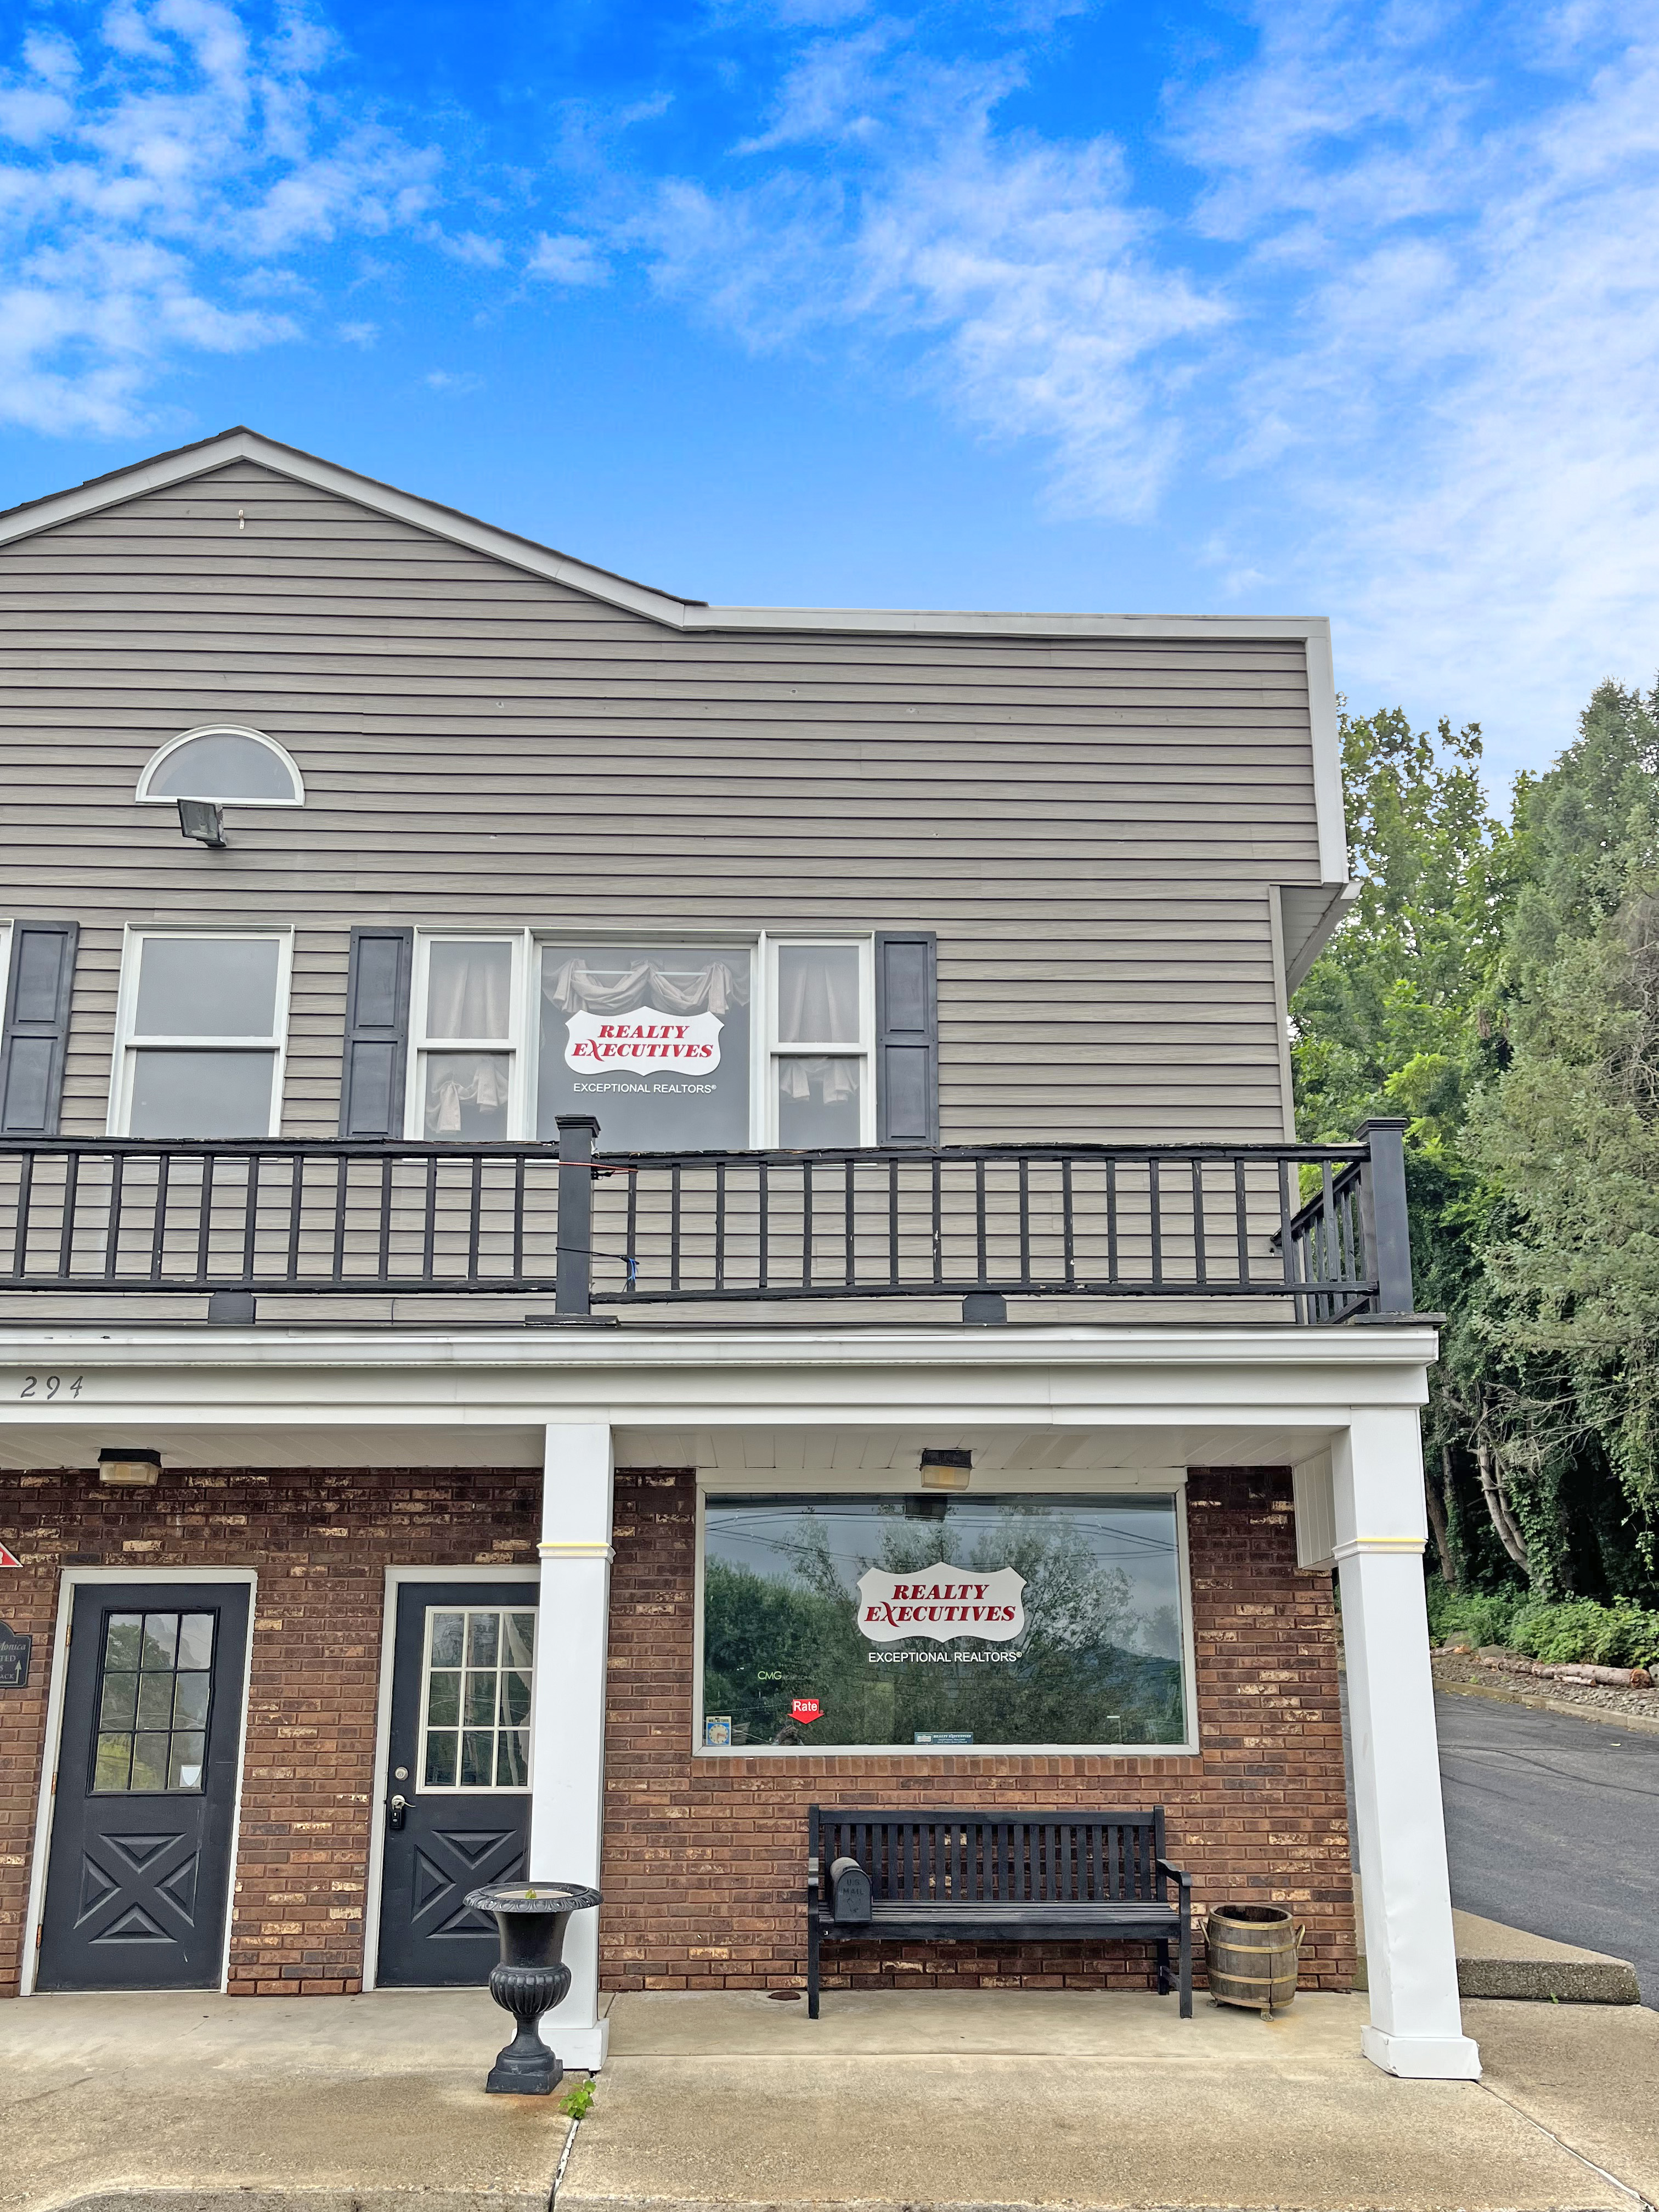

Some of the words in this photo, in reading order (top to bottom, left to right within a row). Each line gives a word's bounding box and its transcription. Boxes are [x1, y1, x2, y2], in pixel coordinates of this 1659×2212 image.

[597, 1025, 690, 1039] REALTY
[571, 1039, 714, 1062] EXECUTIVES
[573, 1083, 651, 1093] EXCEPTIONAL
[20, 1375, 83, 1400] 294
[891, 1584, 990, 1600] REALTY
[864, 1601, 1016, 1628] EXECUTIVES
[868, 1652, 951, 1663] EXCEPTIONAL
[758, 1671, 782, 1680] CMG
[793, 1701, 817, 1711] Rate
